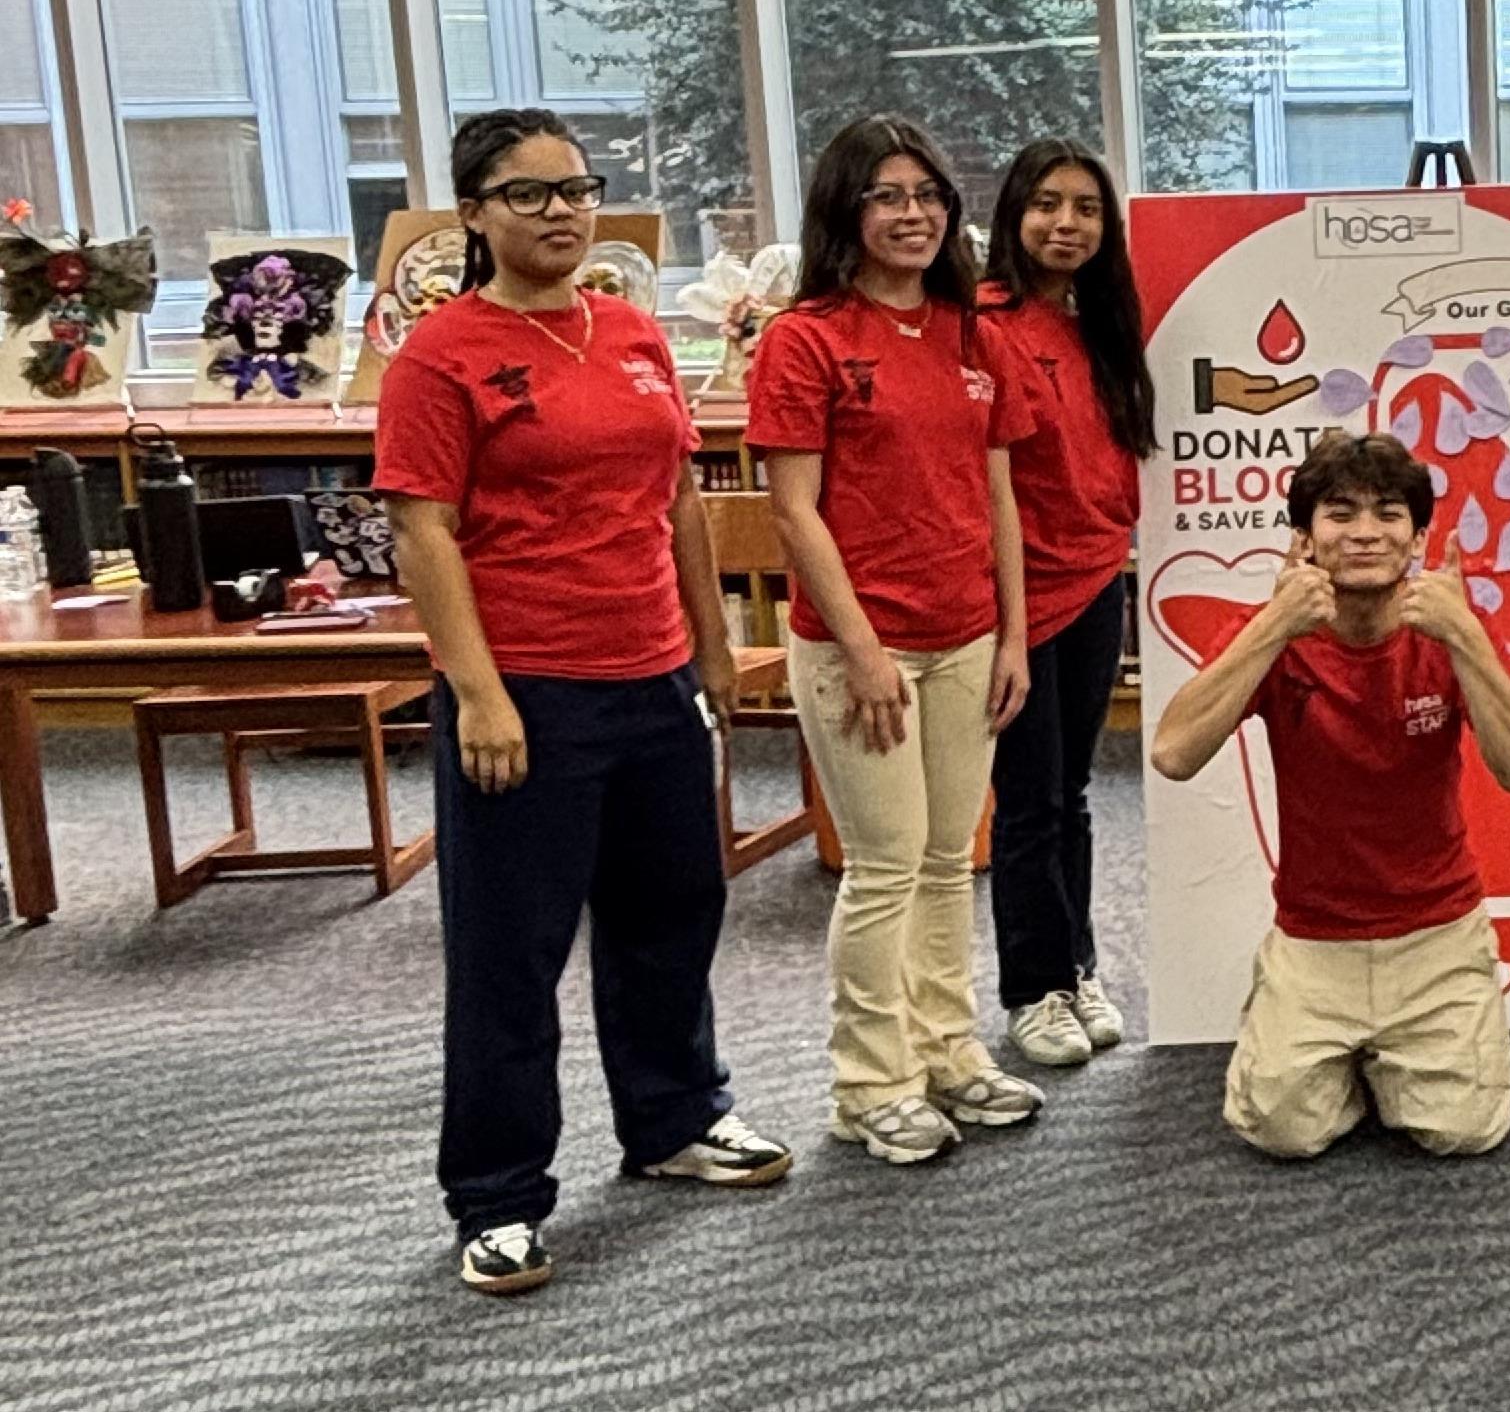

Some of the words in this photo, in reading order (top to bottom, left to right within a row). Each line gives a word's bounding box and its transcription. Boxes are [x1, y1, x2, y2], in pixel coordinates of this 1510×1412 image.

[1324, 206, 1415, 244] hosa
[1446, 302, 1487, 319] Our
[1173, 426, 1343, 462] DONAT
[1174, 512, 1190, 532] &
[1198, 510, 1265, 531] SAVE
